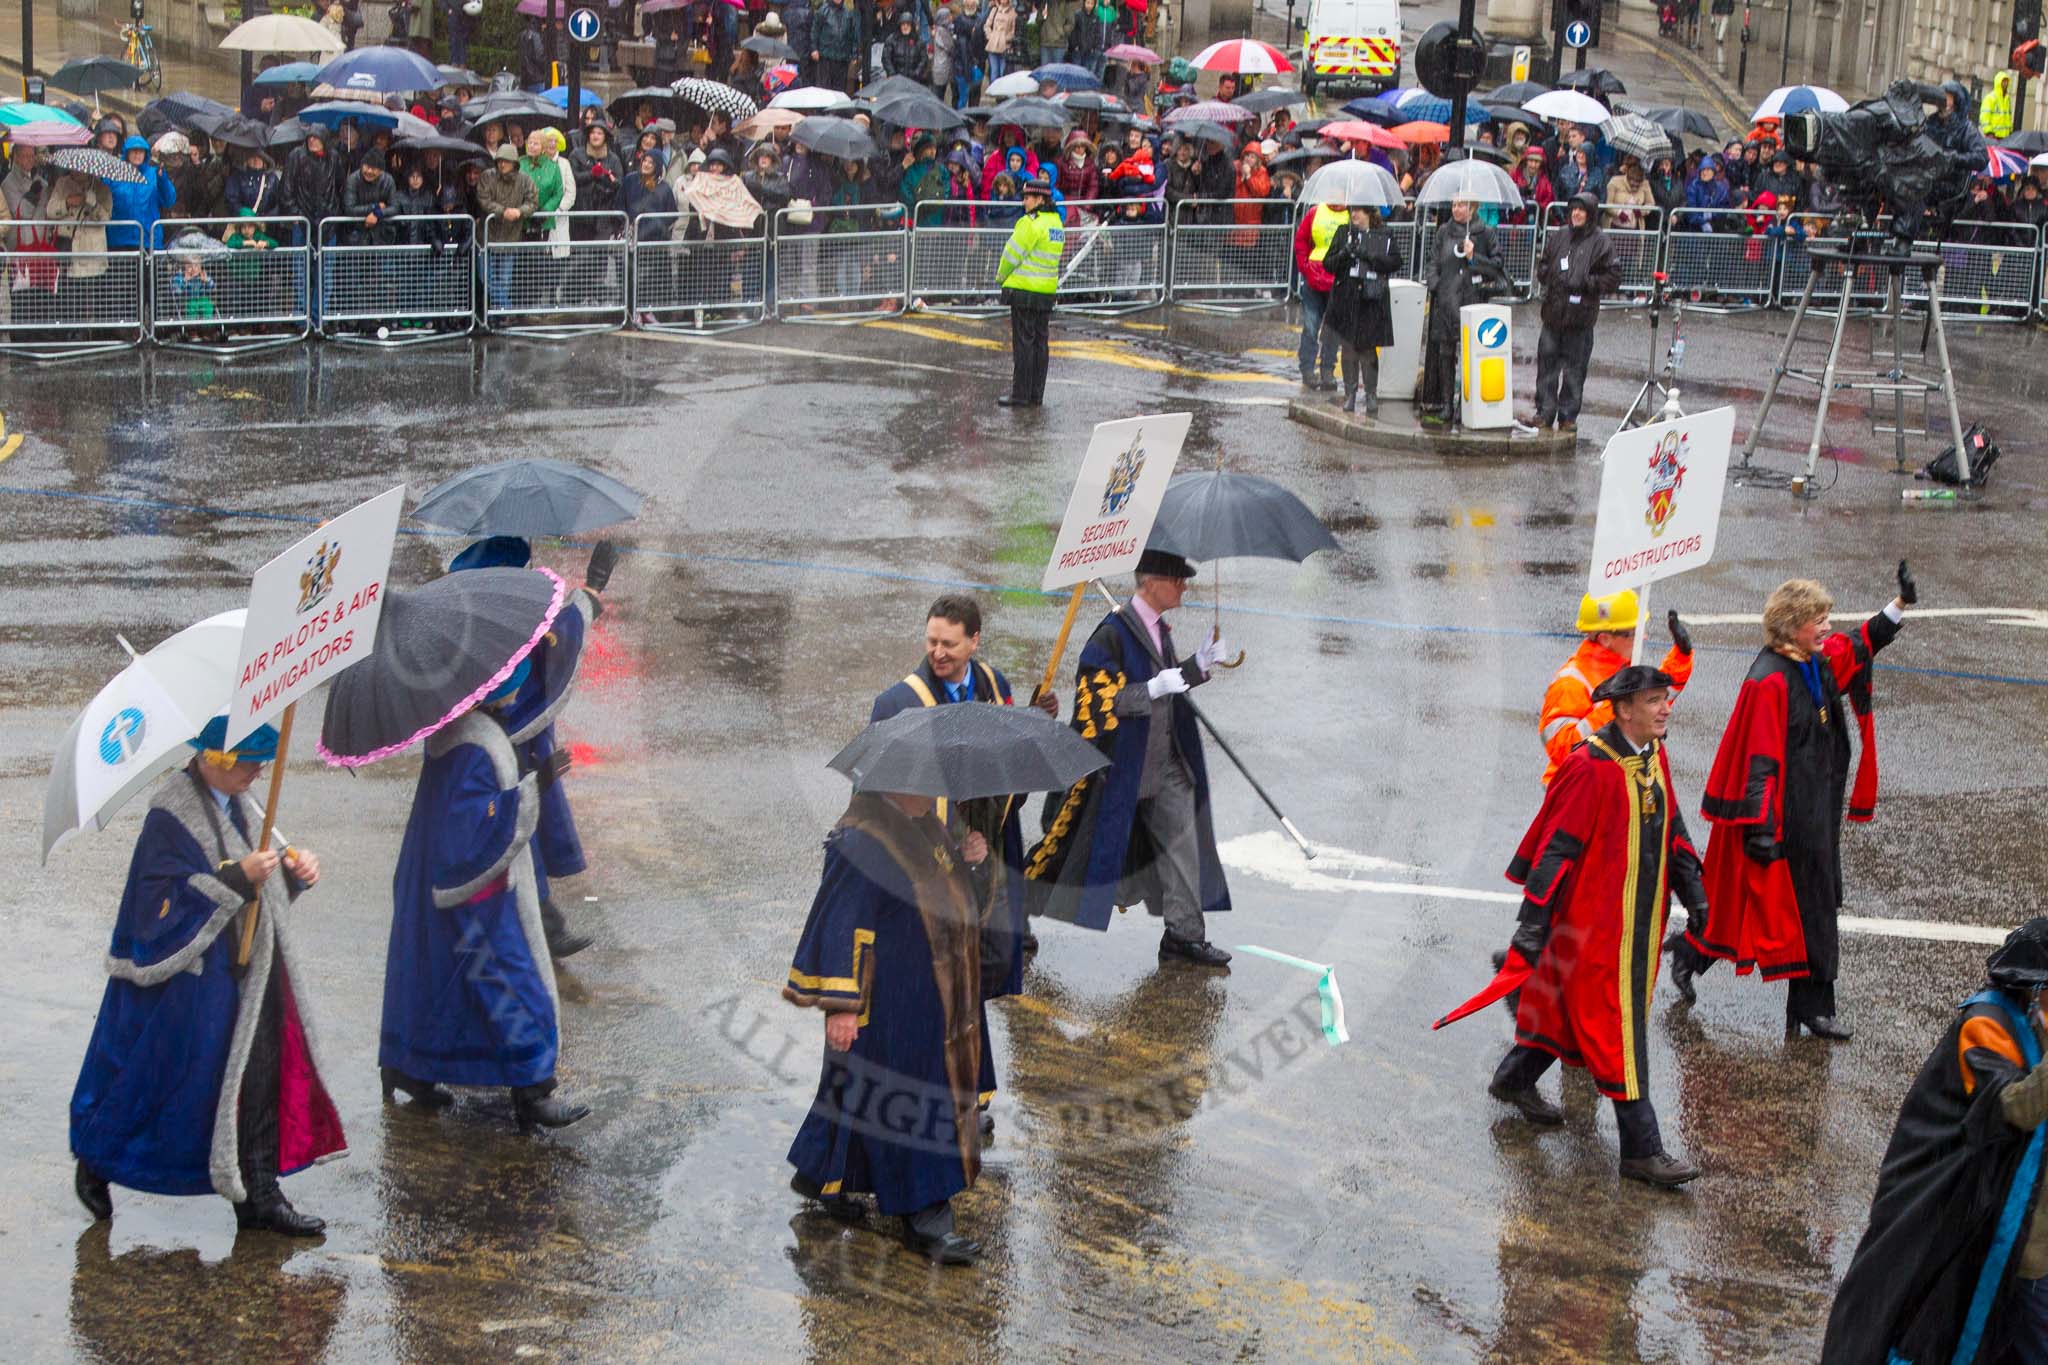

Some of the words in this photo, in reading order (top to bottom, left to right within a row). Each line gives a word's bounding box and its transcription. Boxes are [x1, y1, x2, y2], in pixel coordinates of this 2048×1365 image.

[1058, 537, 1138, 570] PROFESSIONALS
[1081, 519, 1130, 545] SECURITY
[1604, 534, 1702, 579] CONSTRUCTORS
[239, 651, 269, 689] AIR
[271, 610, 330, 666] PILOTS
[332, 600, 345, 624] &
[348, 582, 380, 616] AIR
[249, 630, 354, 717] NAVIGATORS
